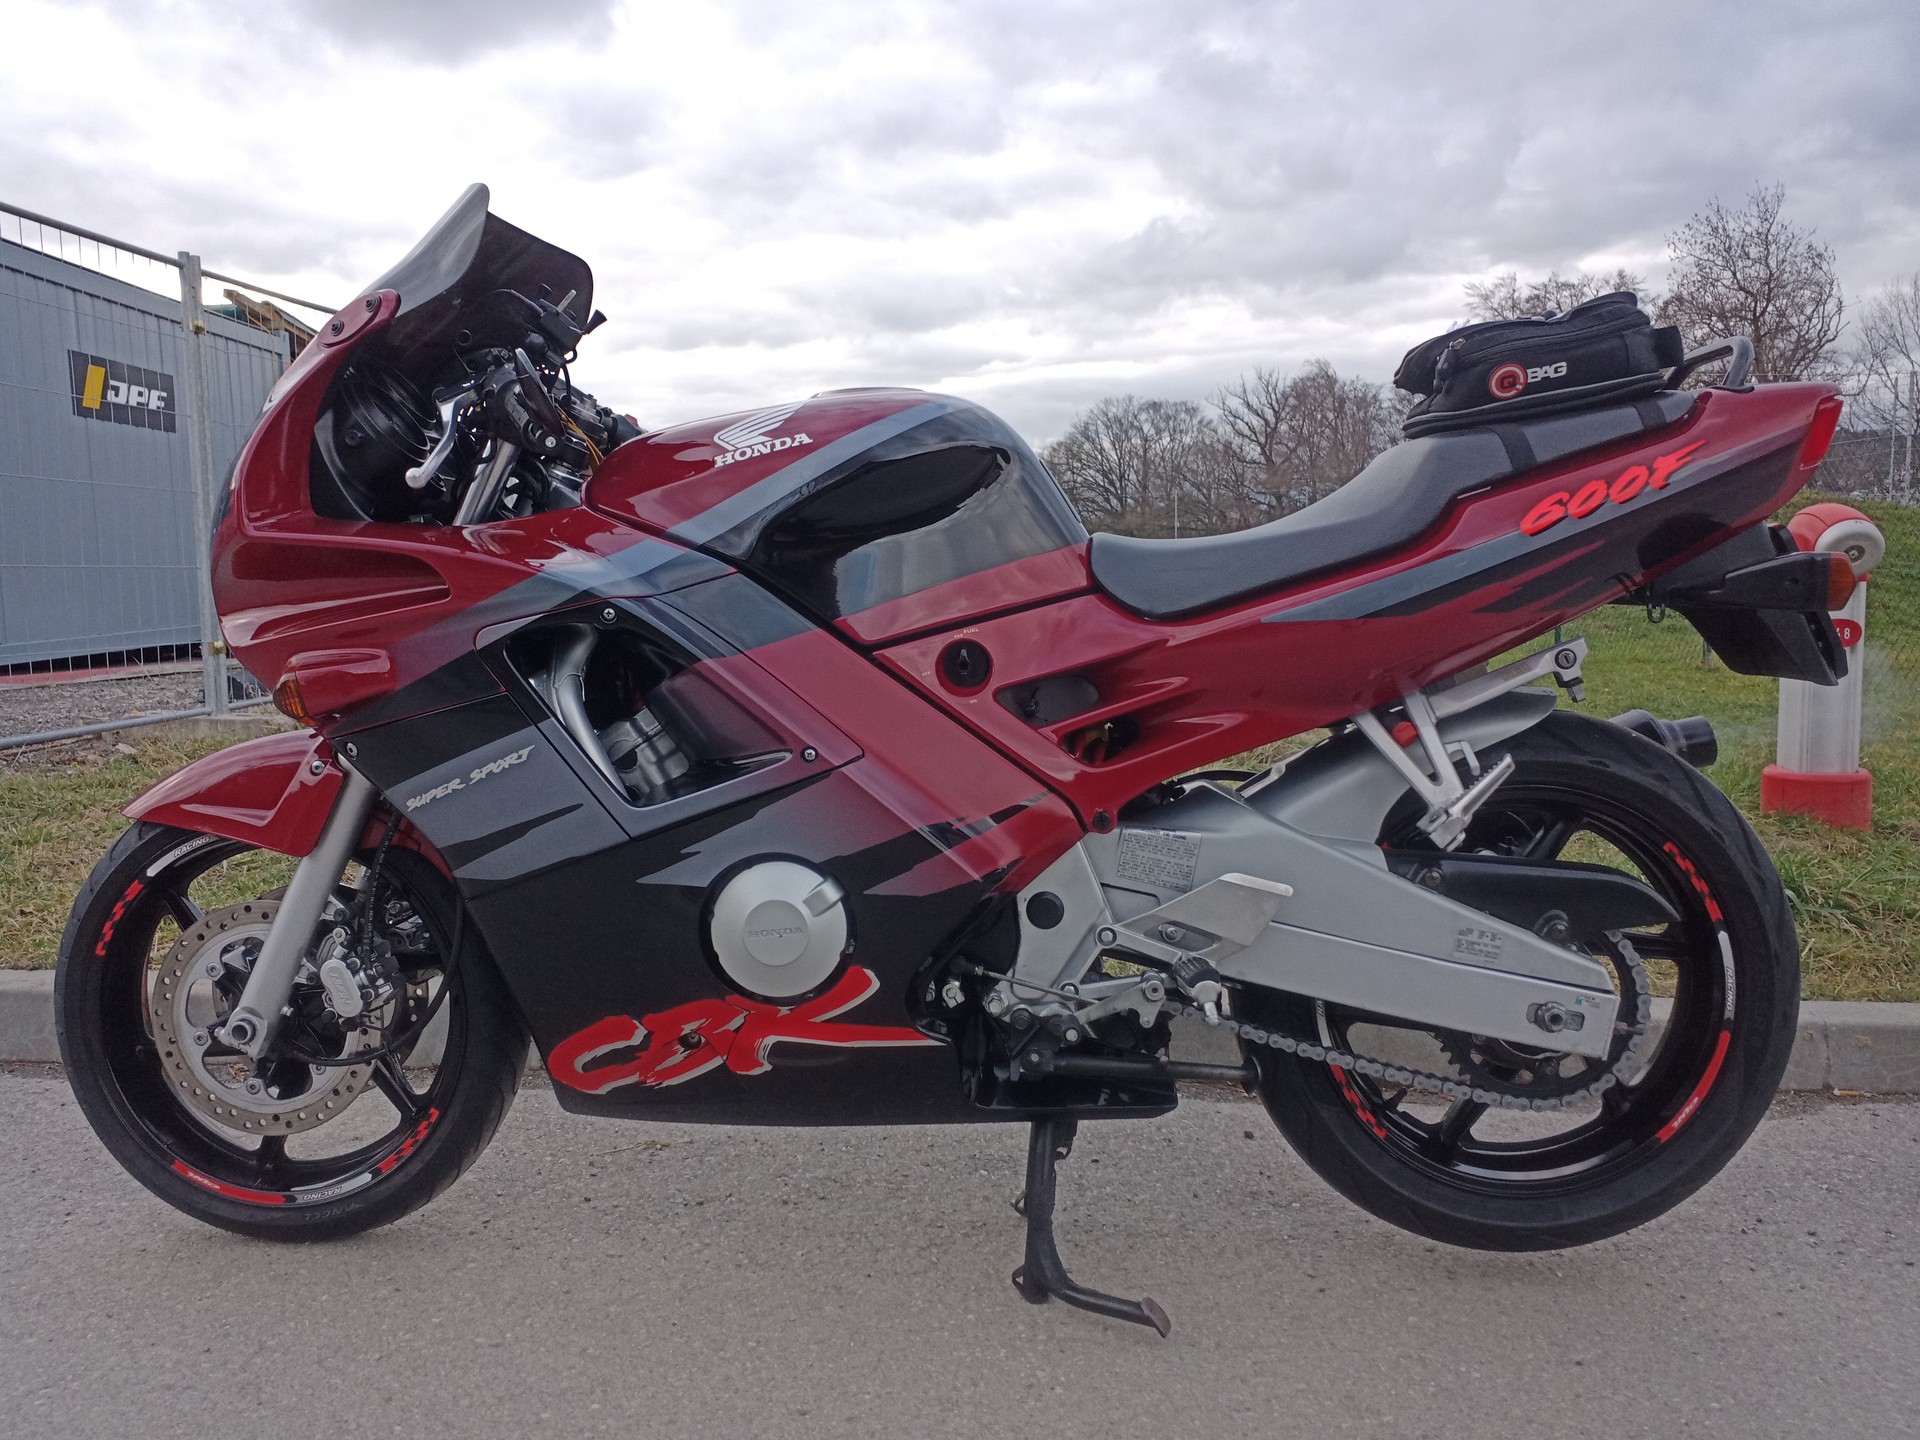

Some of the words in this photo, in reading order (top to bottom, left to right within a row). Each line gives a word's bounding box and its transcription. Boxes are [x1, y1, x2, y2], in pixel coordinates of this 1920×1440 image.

[1527, 361, 1567, 383] BAG
[714, 433, 813, 468] HONDA
[1519, 439, 1707, 537] 600F
[405, 778, 466, 812] SUPER
[469, 744, 536, 785] SPORT
[174, 836, 211, 857] RACING
[747, 927, 805, 939] HONDA
[548, 965, 952, 1095] CBR
[303, 1186, 342, 1200] RACING
